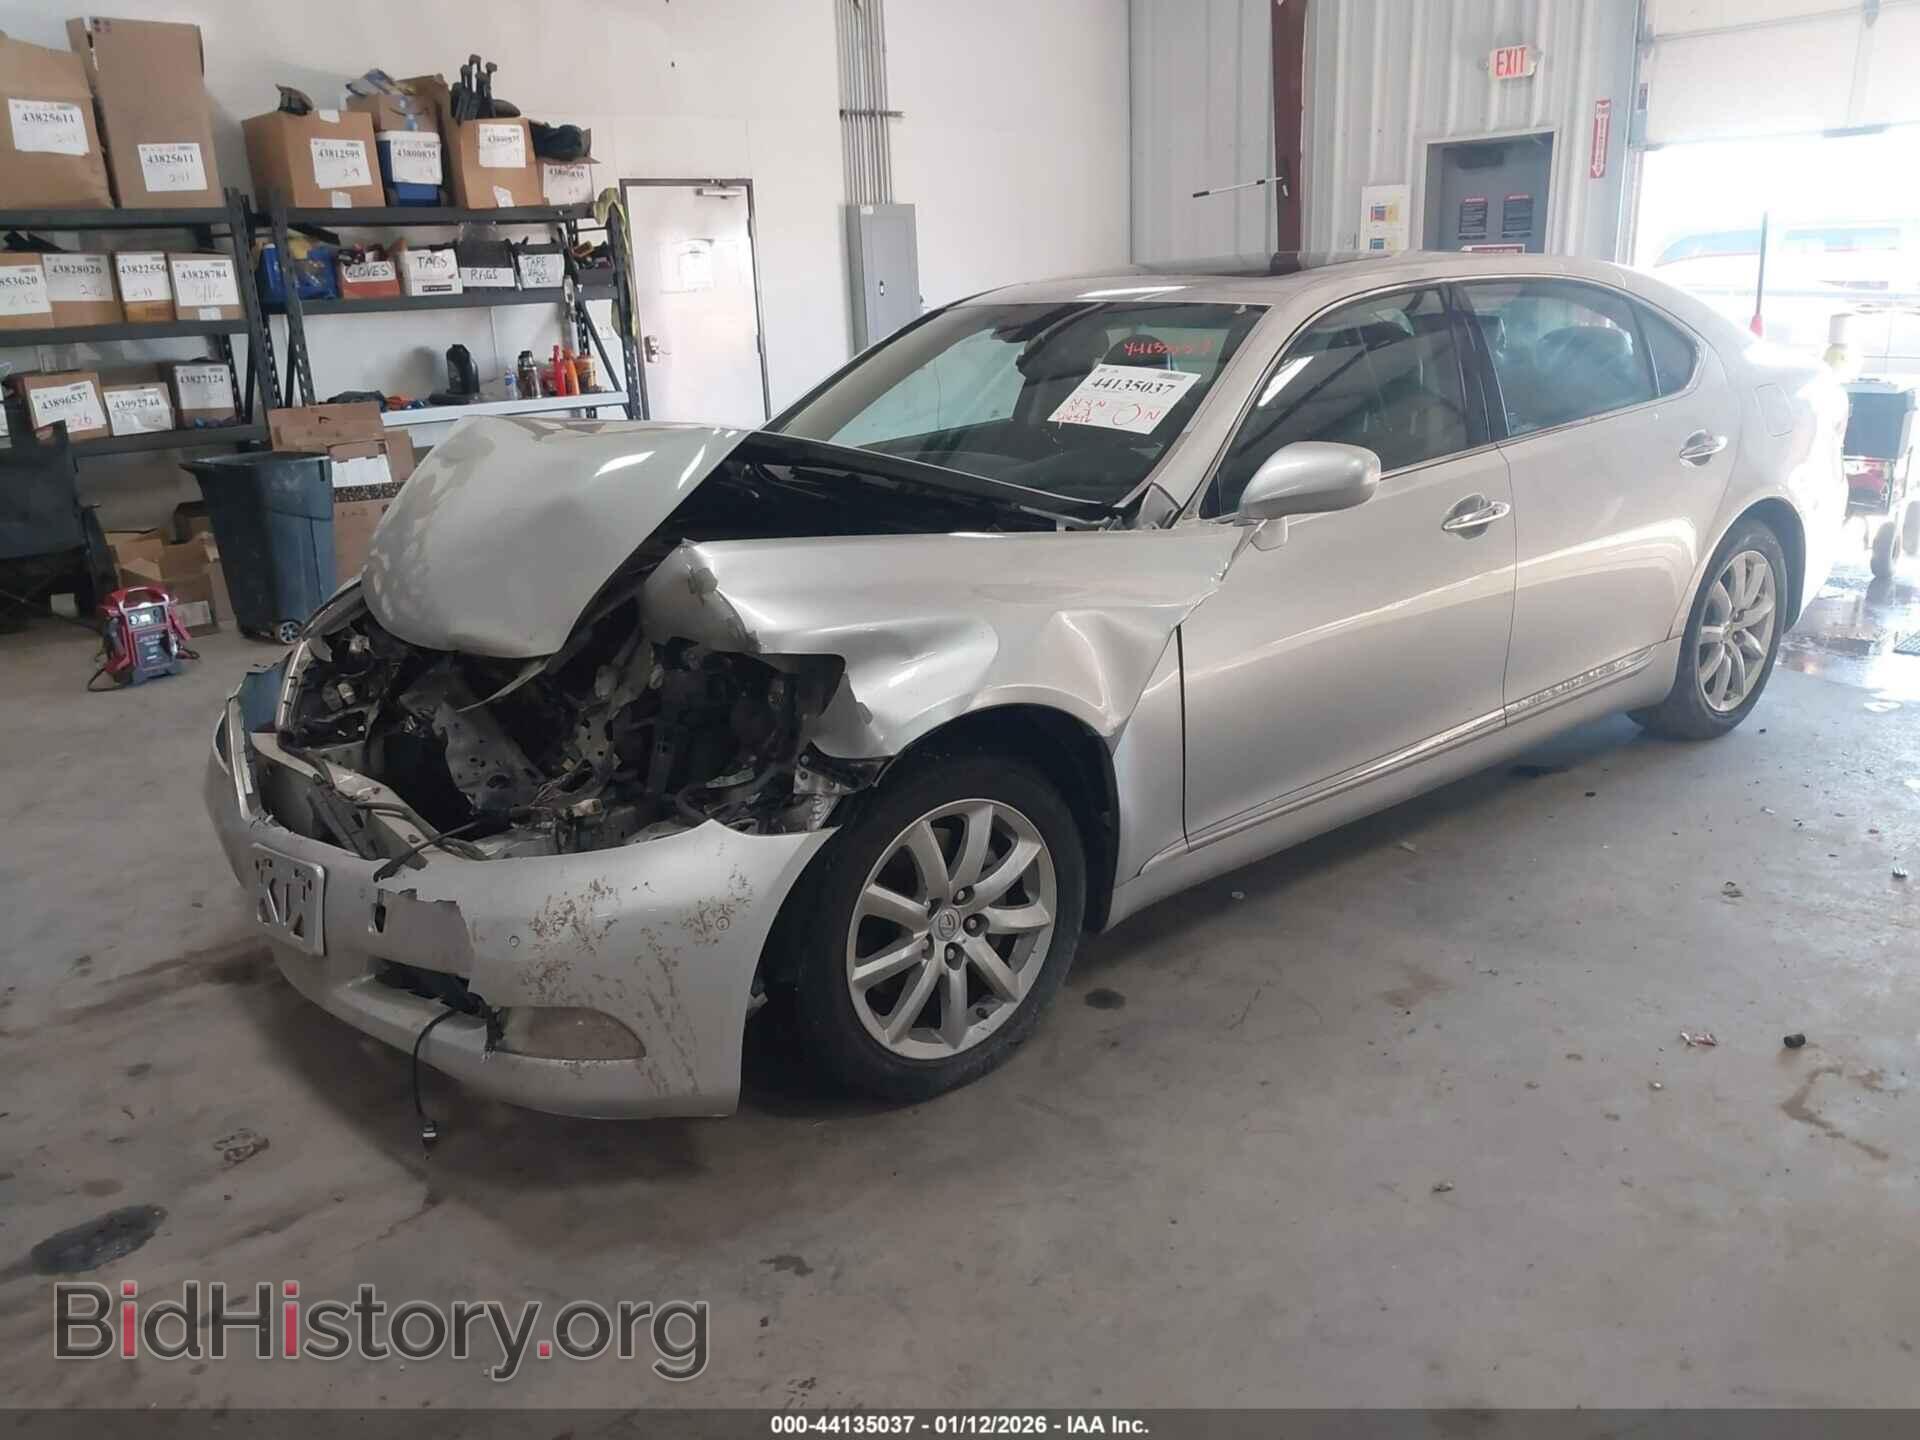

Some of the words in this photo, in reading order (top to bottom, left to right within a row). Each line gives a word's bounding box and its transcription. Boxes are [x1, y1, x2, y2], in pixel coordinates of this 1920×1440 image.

[1495, 47, 1526, 77] EXIT
[22, 112, 75, 123] 43825611
[417, 256, 448, 269] TAGS
[53, 265, 102, 274] 43828026
[470, 269, 498, 281] RAGS
[180, 375, 224, 385] 43827124
[1091, 377, 1176, 394] 44135037
